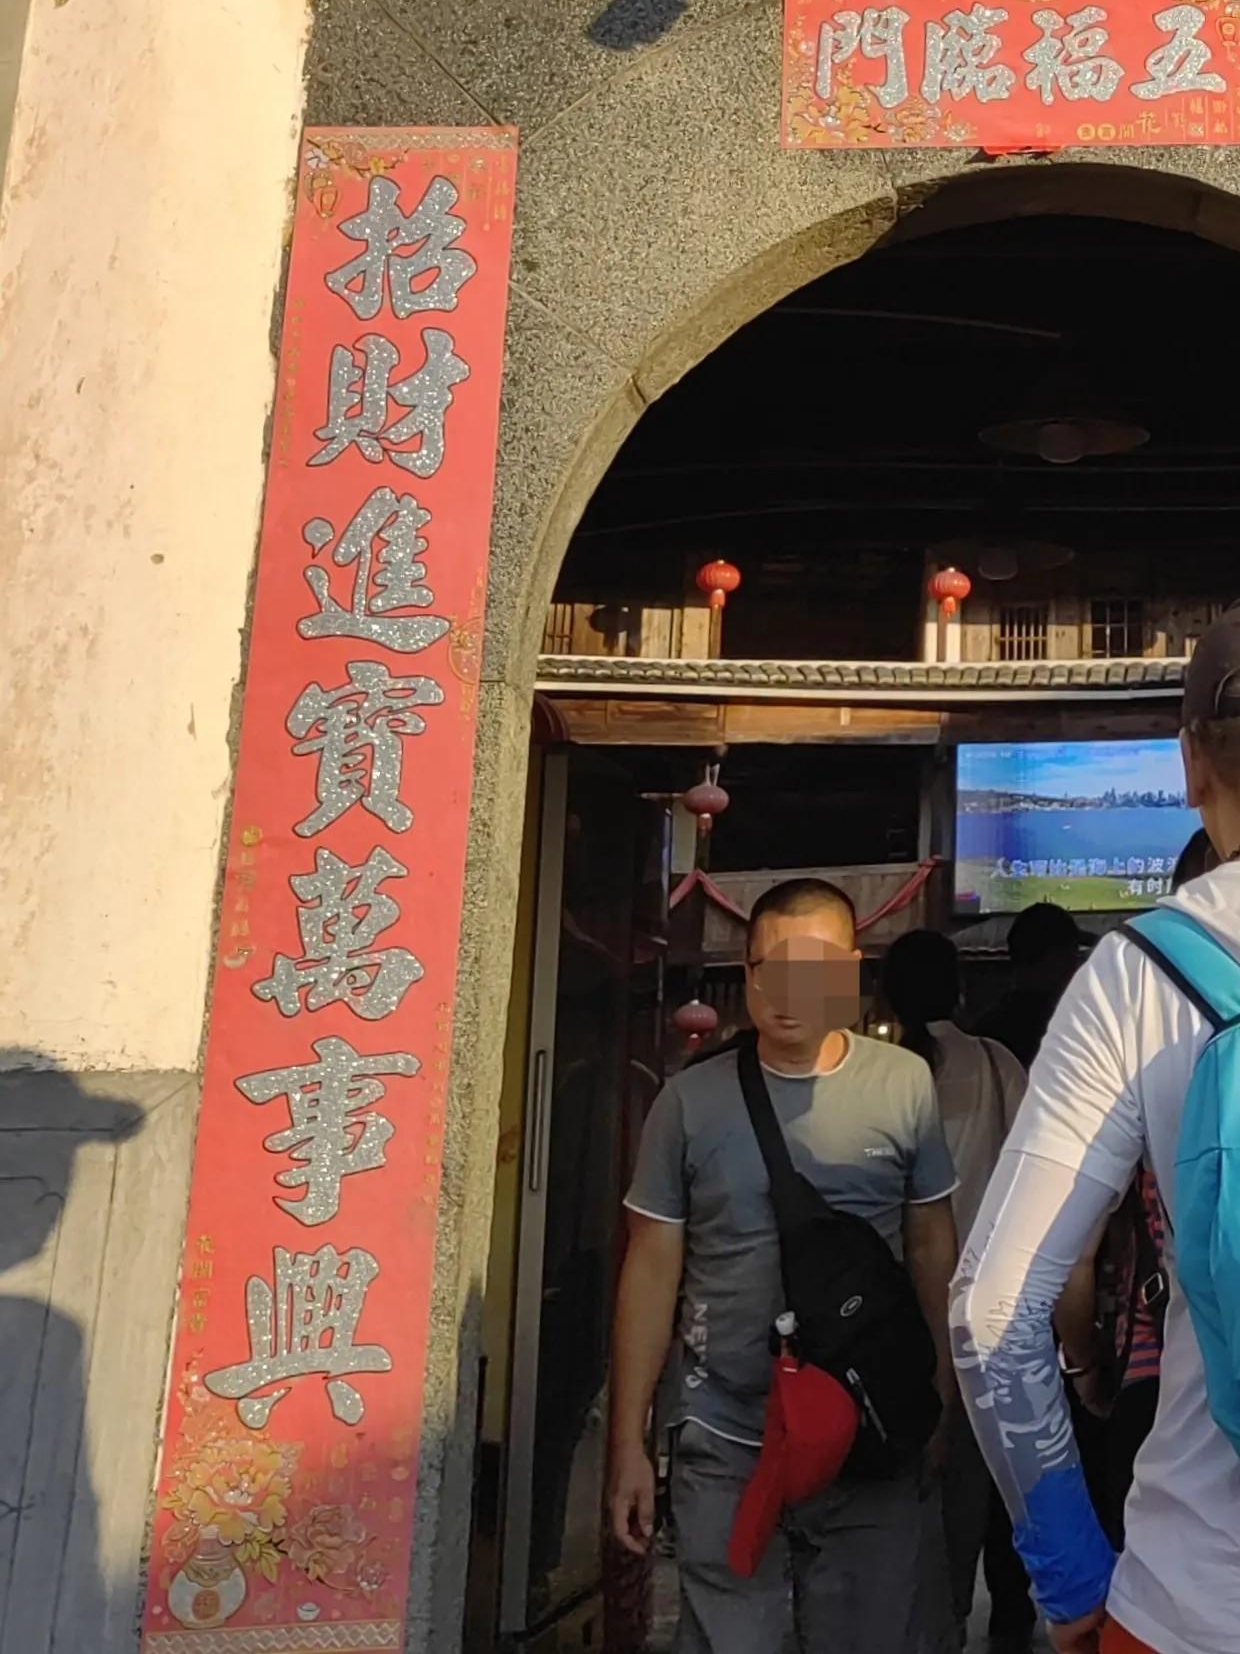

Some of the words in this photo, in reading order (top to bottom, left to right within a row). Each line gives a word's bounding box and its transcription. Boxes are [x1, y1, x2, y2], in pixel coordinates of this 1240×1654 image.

[204, 175, 477, 1430] 招財進寶萬事興
